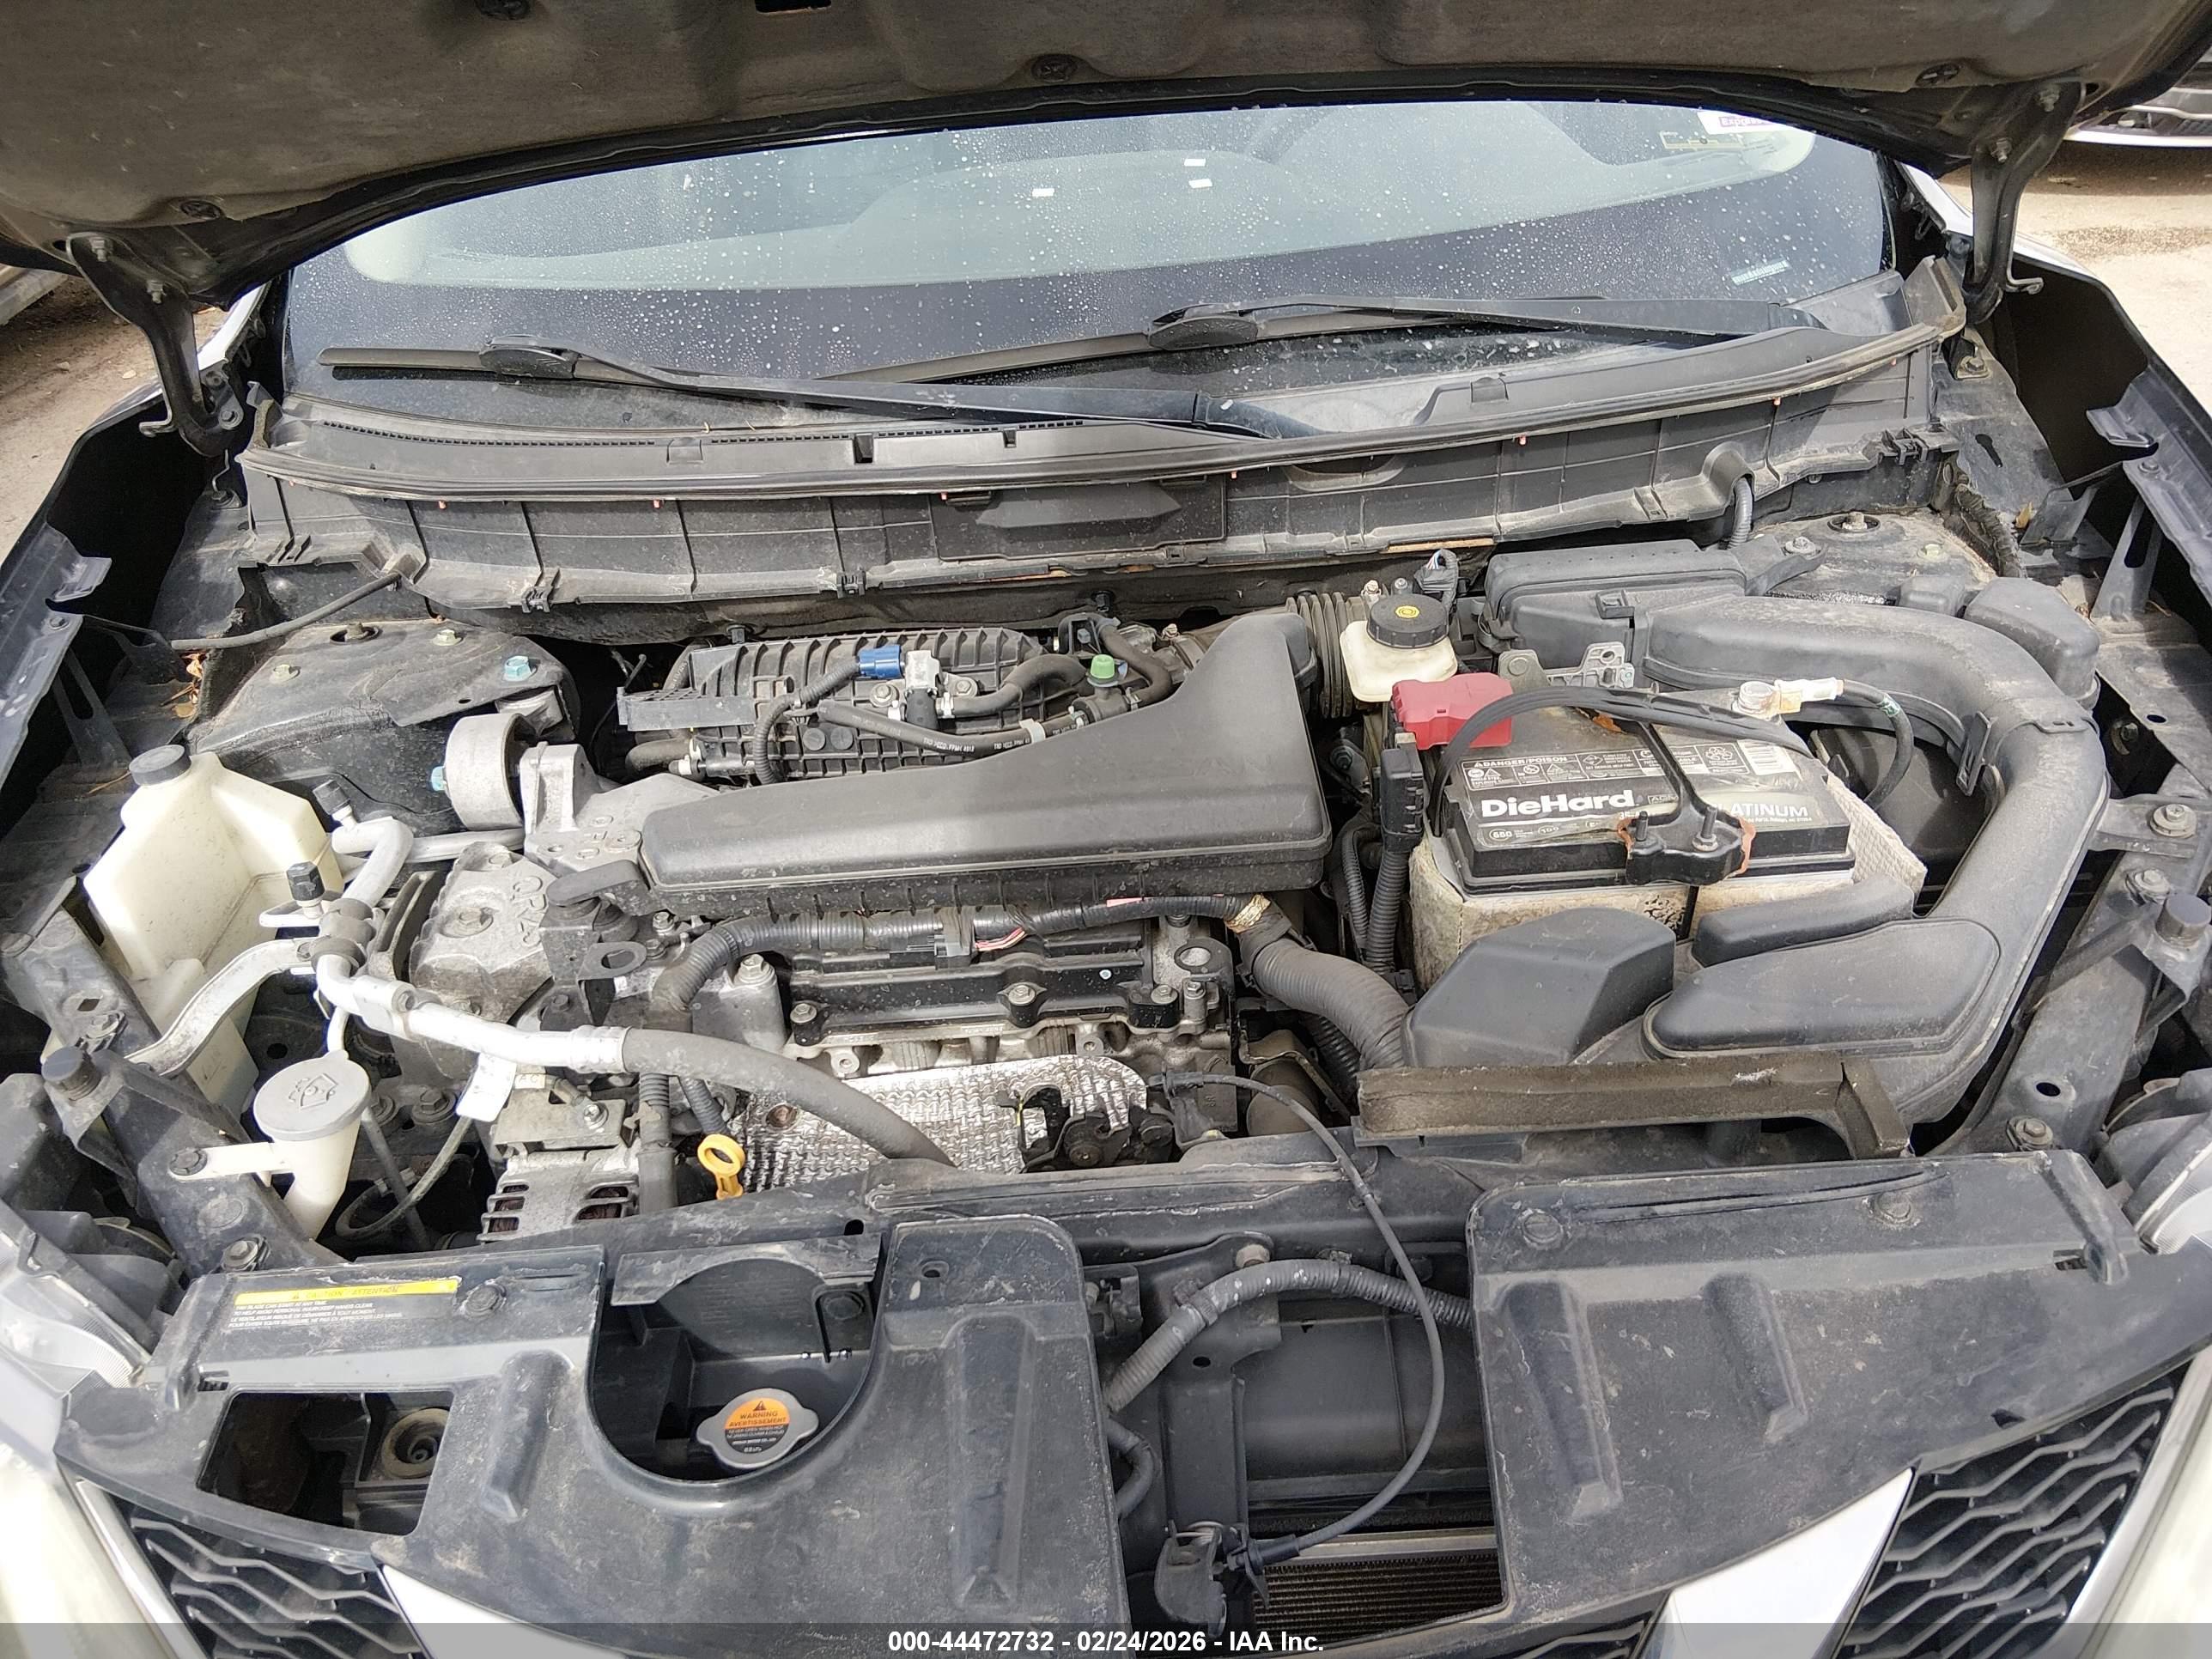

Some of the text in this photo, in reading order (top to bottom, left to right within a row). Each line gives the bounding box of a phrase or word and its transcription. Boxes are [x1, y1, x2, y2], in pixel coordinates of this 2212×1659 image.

[1484, 757, 1566, 767] DANGER/POISON
[1481, 790, 1635, 817] DieHard
[1715, 803, 1808, 817] LATINUM
[351, 1285, 399, 1295] ATTENTION
[740, 1410, 778, 1419] WARNING
[729, 1417, 786, 1426] AVERTISSEMENT
